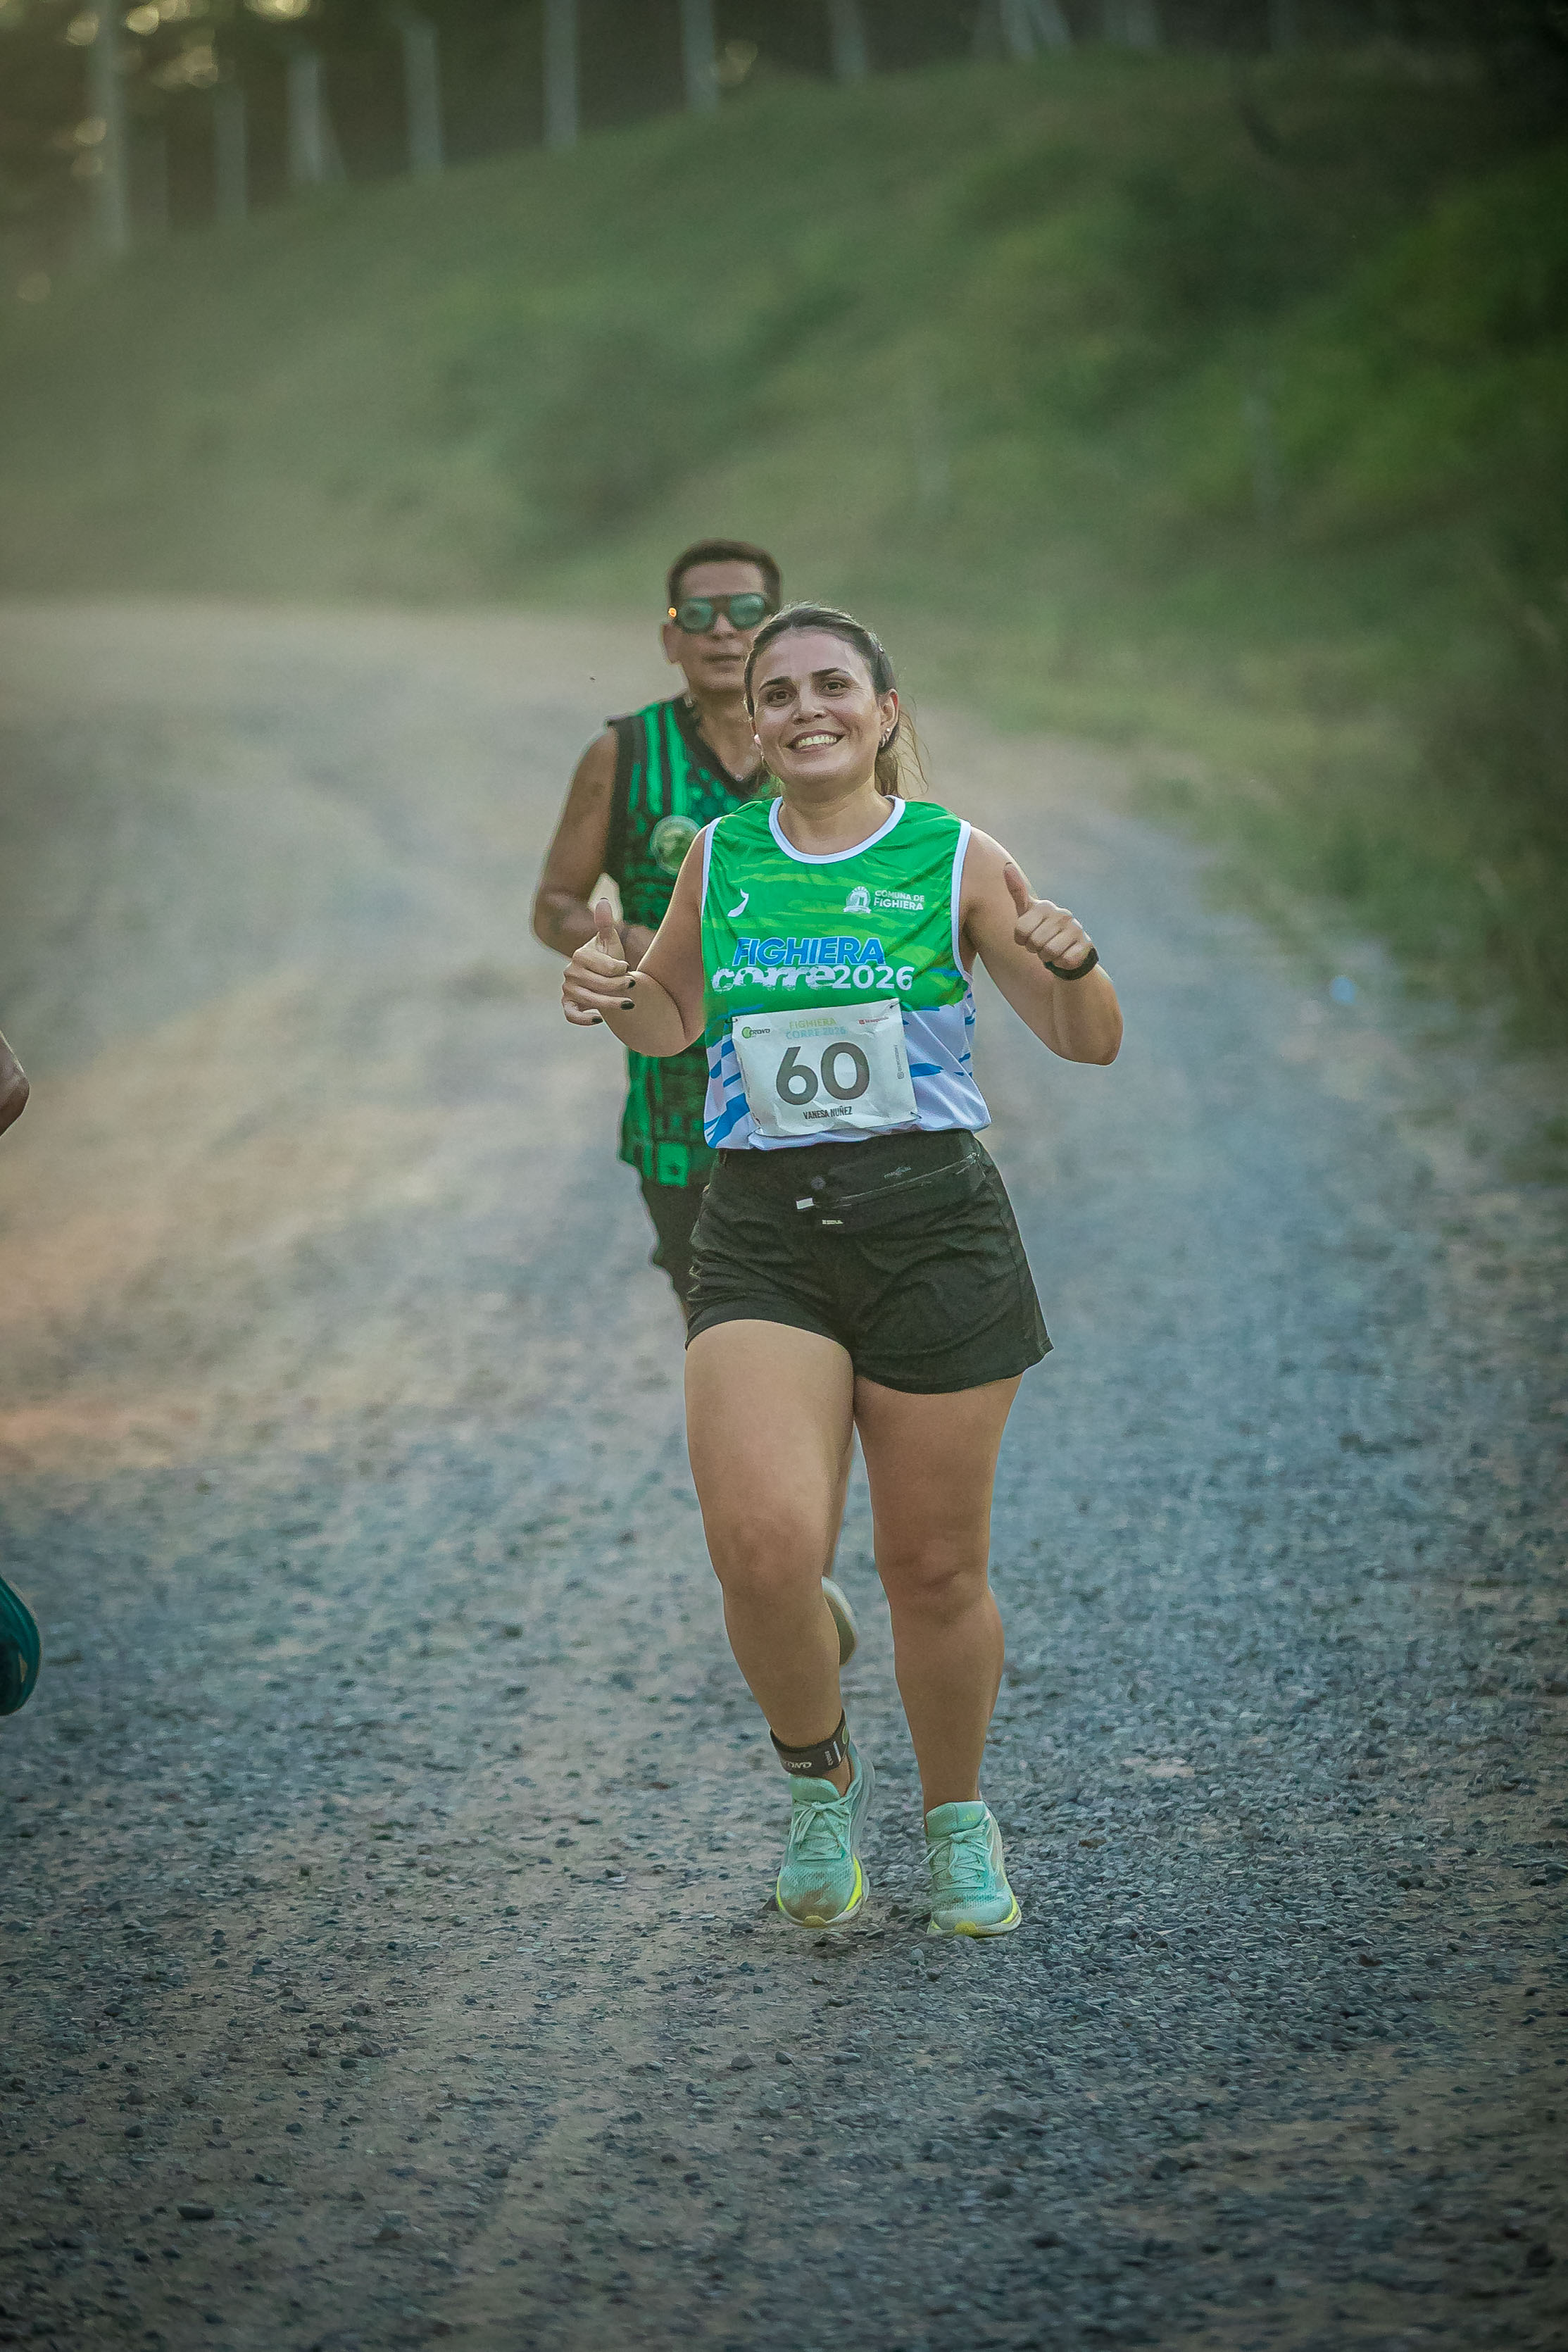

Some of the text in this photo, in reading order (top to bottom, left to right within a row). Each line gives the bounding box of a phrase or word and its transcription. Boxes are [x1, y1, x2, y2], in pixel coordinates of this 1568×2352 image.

[874, 889, 911, 901] COMUNA
[874, 897, 924, 911] FIGHIERA
[733, 937, 885, 965] FIGHIERA
[789, 1018, 836, 1030] FIGHIERA
[786, 1029, 820, 1039] CORRE
[776, 1042, 870, 1106] 60
[803, 1105, 853, 1120] VANESA NUÑEZ
